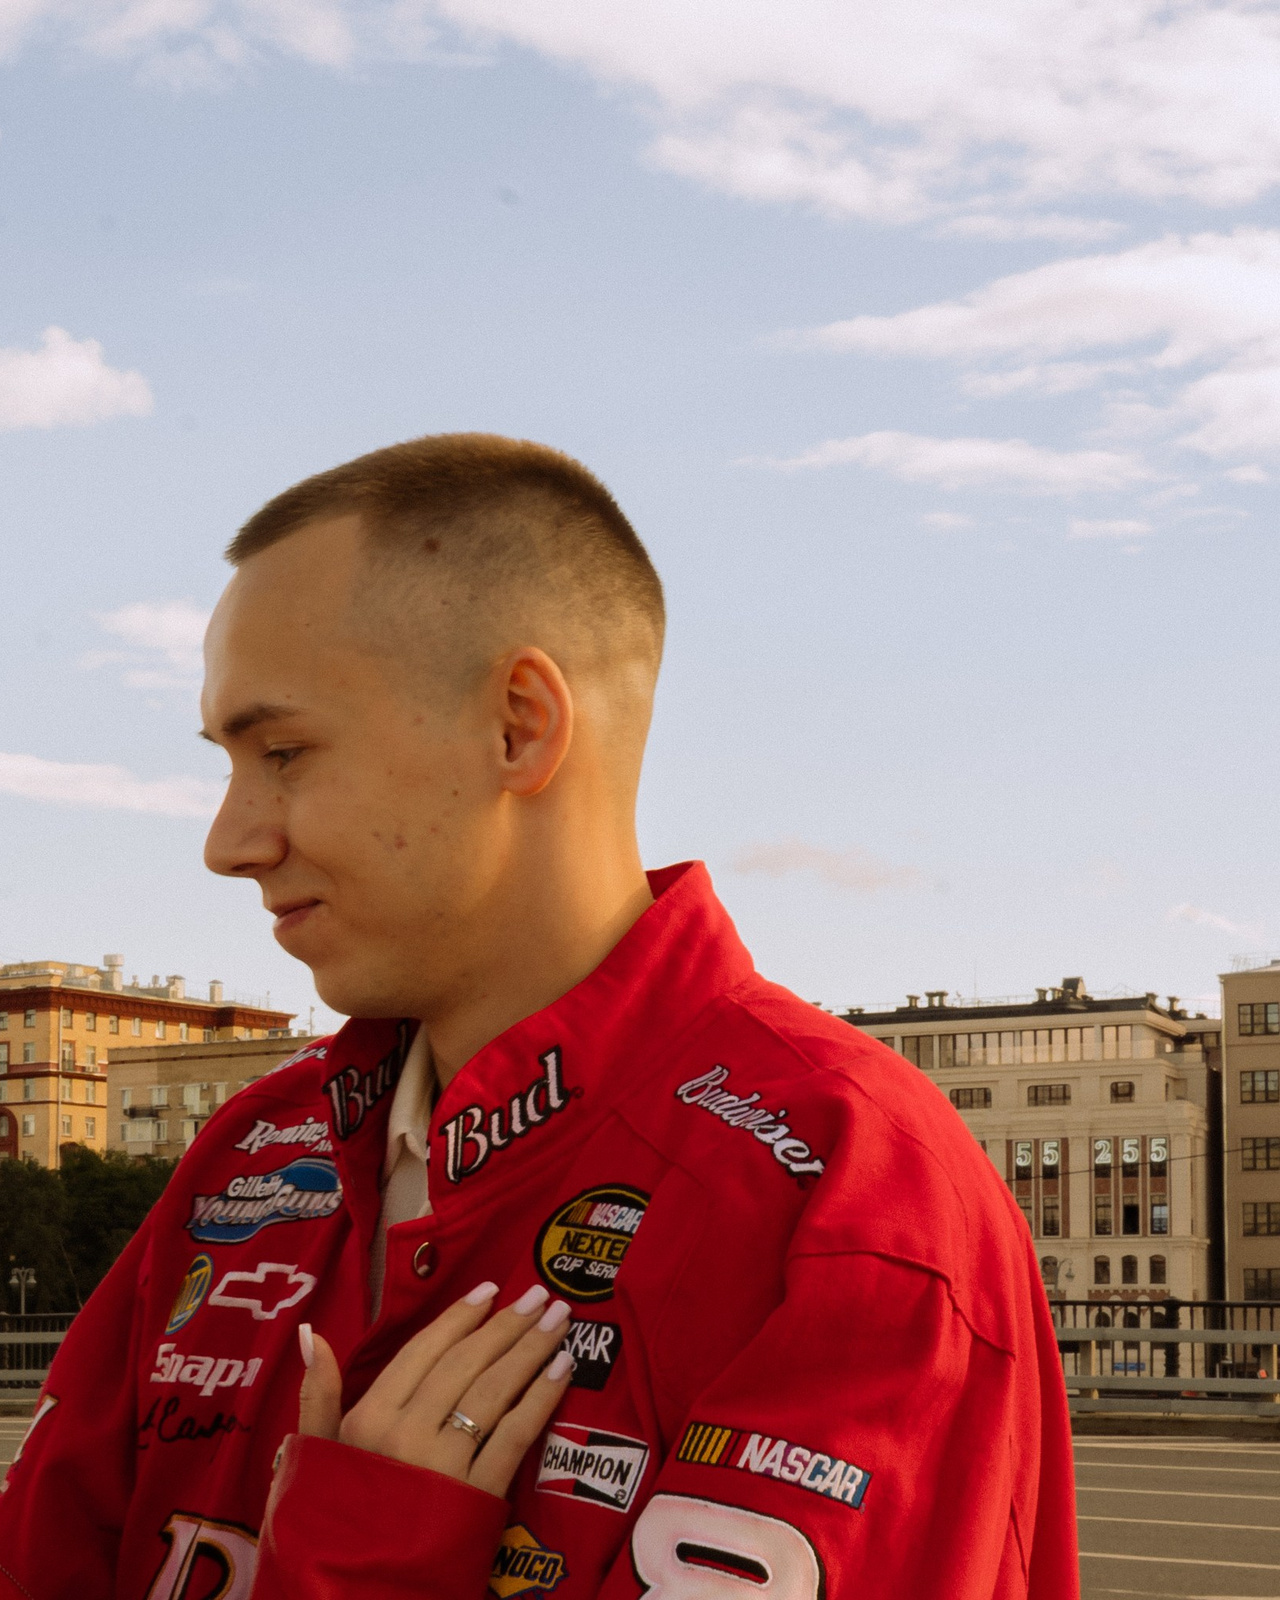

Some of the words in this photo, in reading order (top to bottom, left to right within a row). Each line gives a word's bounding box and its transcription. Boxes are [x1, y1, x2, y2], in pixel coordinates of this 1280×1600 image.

[442, 1048, 566, 1183] Bud
[676, 1064, 825, 1175] Budweiser
[553, 1256, 583, 1272] CUP
[543, 1446, 632, 1486] CHAMPION
[736, 1433, 864, 1503] NASCAR
